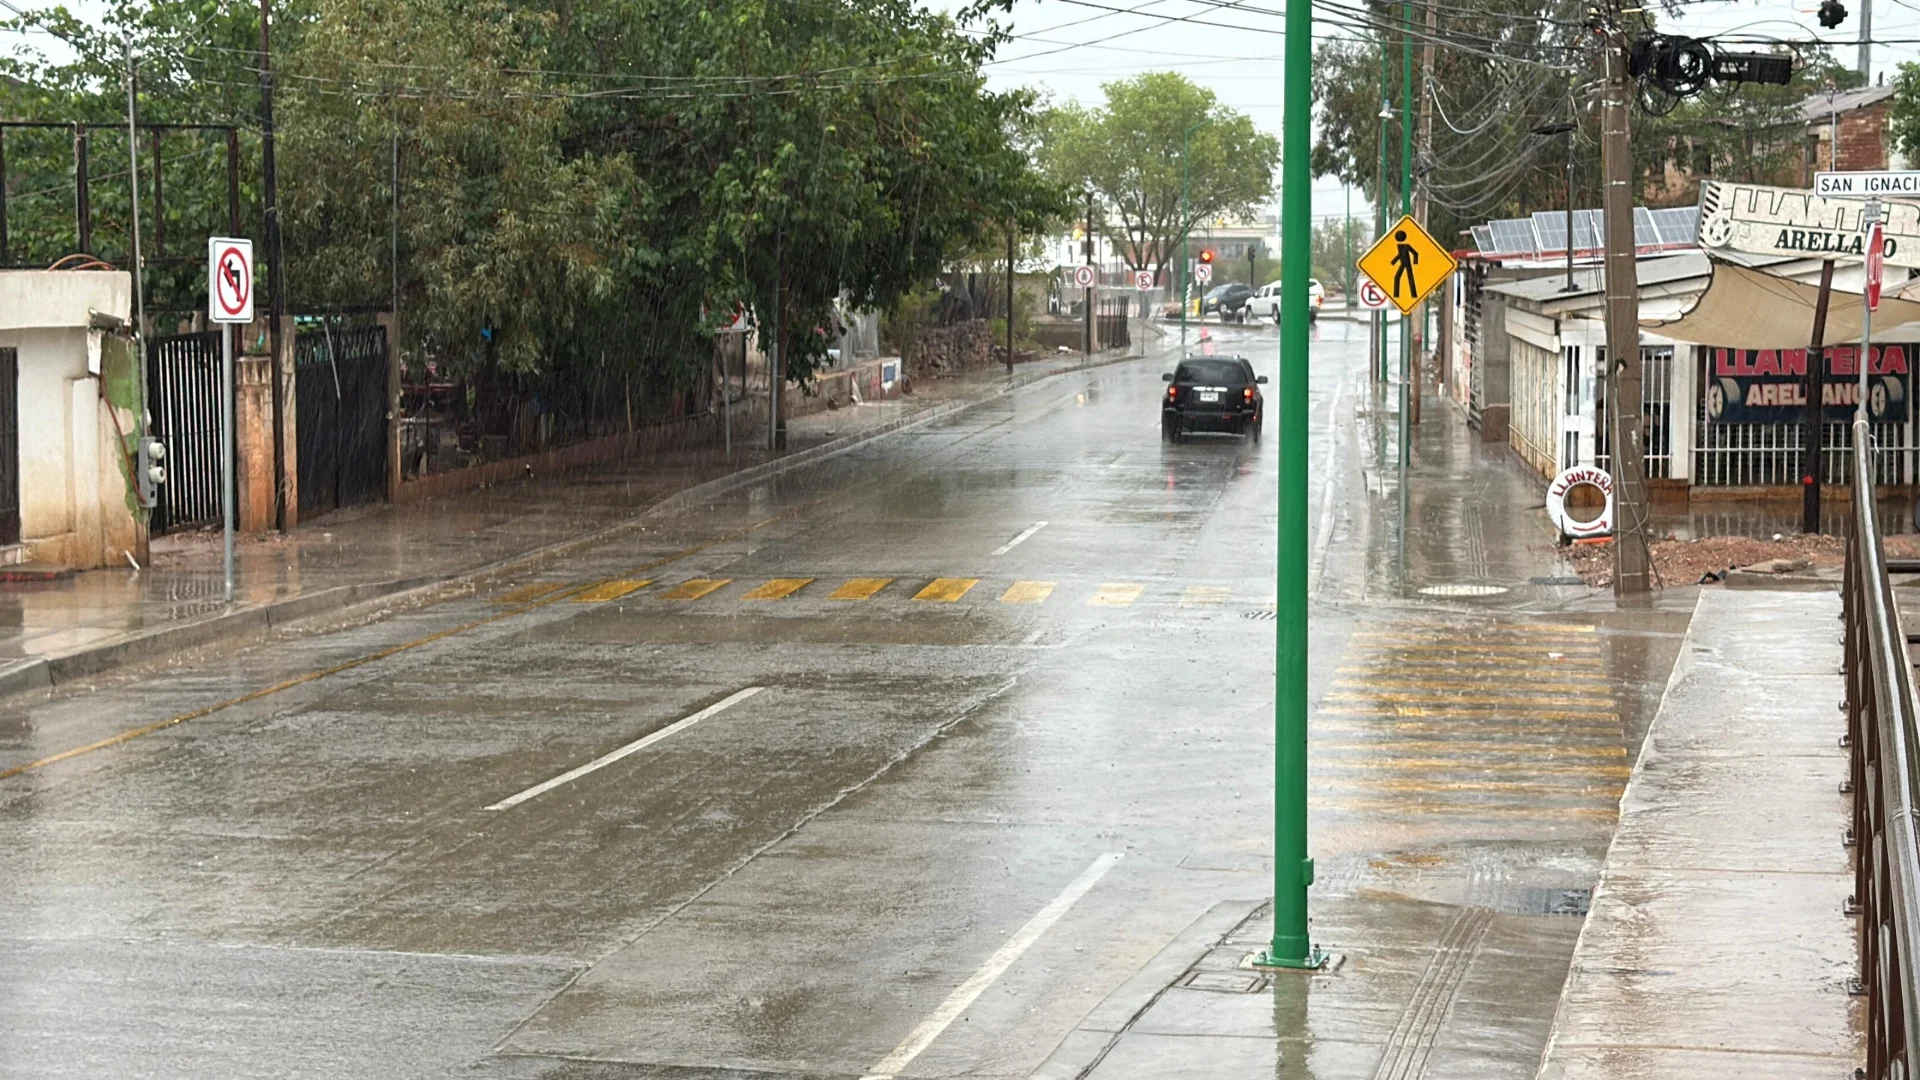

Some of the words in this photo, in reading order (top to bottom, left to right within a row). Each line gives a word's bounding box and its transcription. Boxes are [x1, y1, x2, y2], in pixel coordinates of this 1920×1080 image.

[1821, 178, 1852, 192] SAN
[1865, 176, 1920, 191] IGNACI
[1774, 228, 1897, 258] ARELLAO
[1745, 382, 1870, 406] ARELANO
